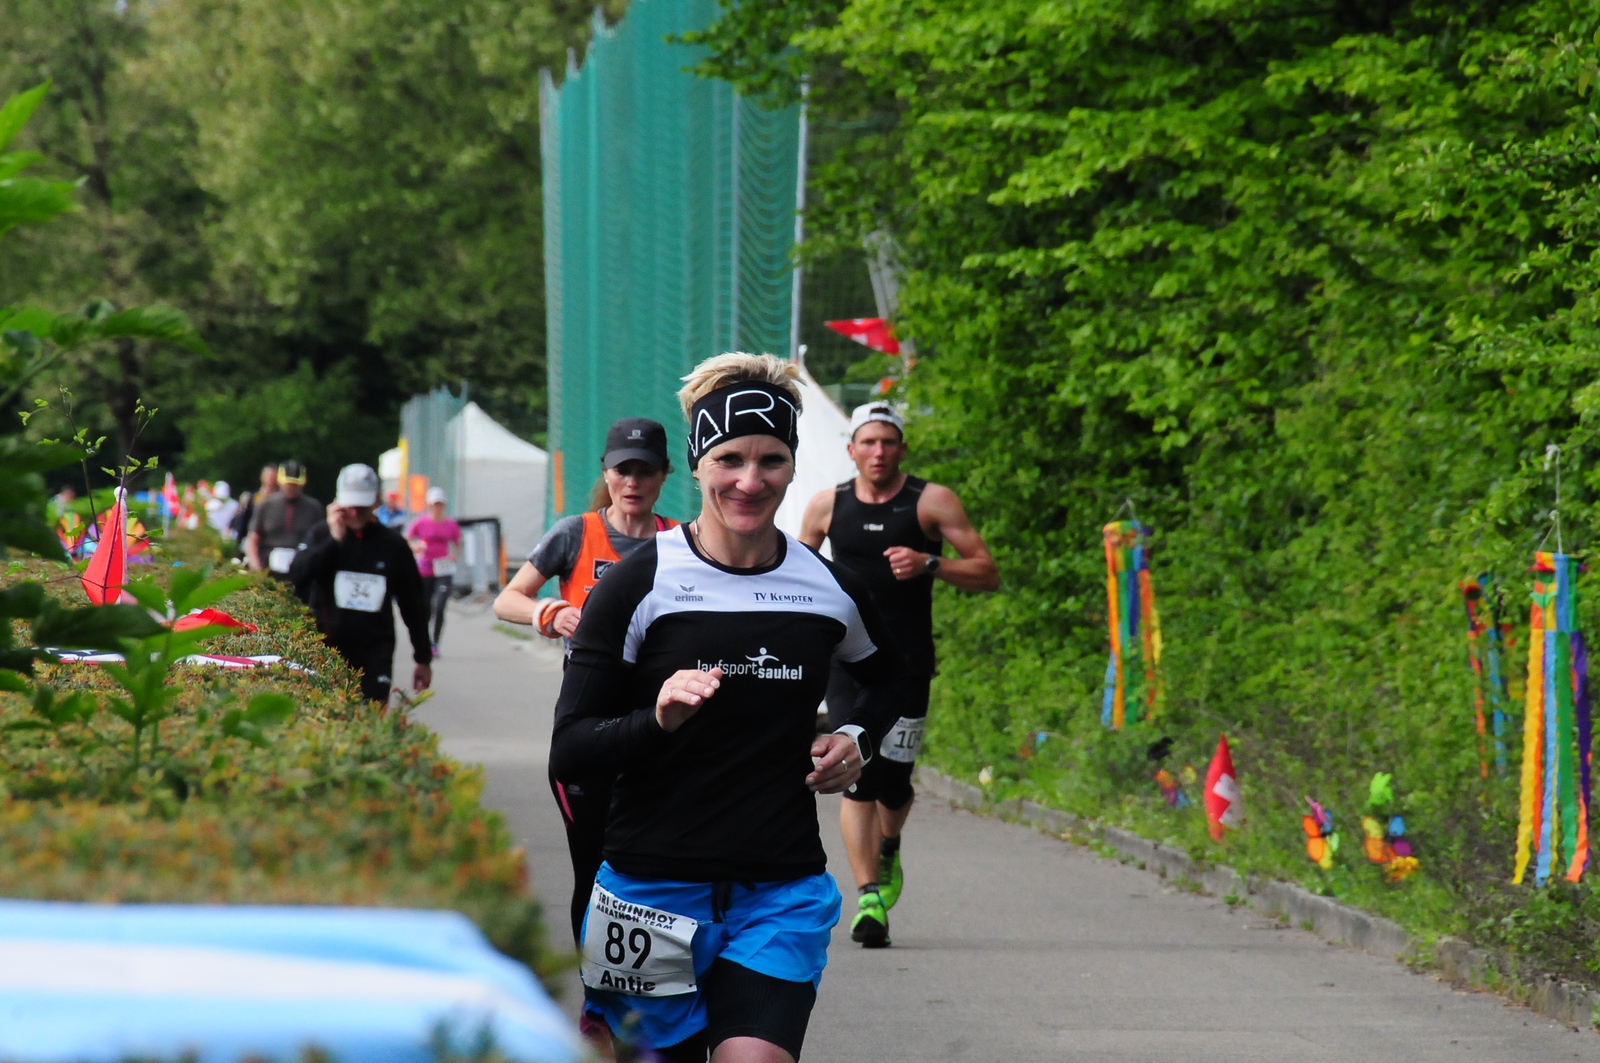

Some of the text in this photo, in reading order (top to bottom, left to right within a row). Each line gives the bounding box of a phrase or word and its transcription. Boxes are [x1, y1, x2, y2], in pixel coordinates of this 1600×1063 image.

[351, 582, 370, 599] 34
[675, 594, 704, 602] erima
[753, 592, 767, 601] TV
[757, 663, 803, 680] saukel
[596, 903, 673, 930] MARATHON TEAM
[599, 892, 677, 925] SRI CHINMOY
[605, 921, 652, 970] 89
[600, 969, 656, 995] Antje
